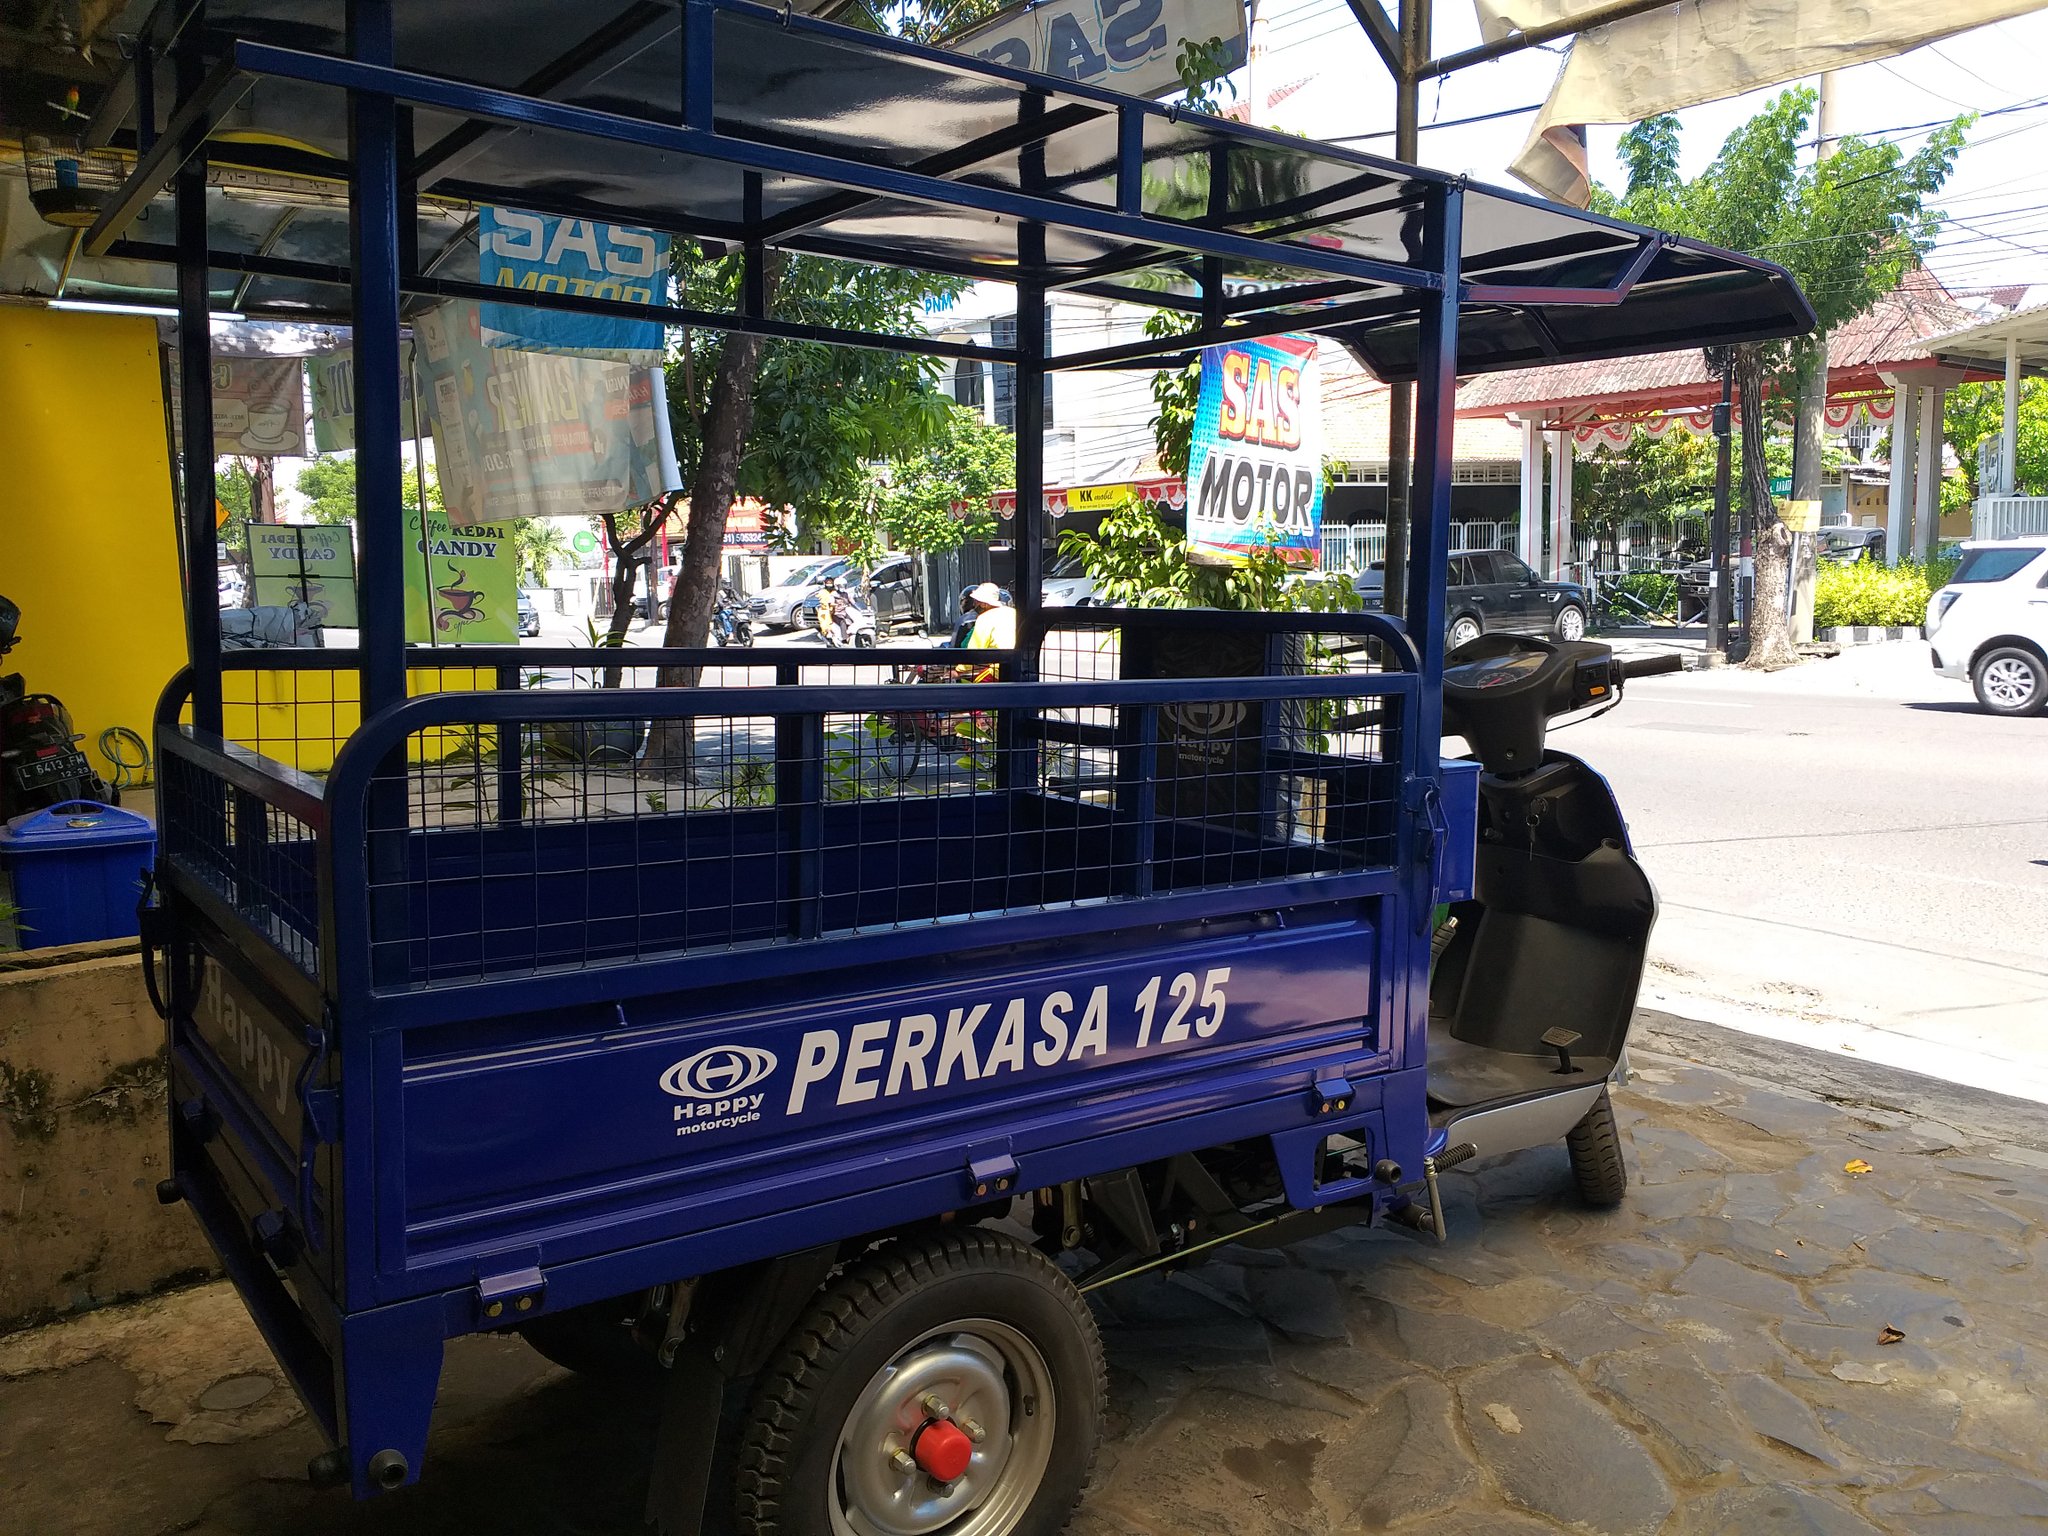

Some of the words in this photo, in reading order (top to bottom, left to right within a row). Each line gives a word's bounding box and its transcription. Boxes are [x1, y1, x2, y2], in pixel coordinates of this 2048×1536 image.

[492, 207, 656, 278] SAS
[925, 292, 953, 315] PNM
[1218, 350, 1300, 452] SAS
[1080, 490, 1093, 502] KK
[1196, 451, 1313, 531] MOTOR
[409, 515, 448, 539] Cffee
[417, 540, 497, 558] GANDY
[22, 768, 31, 778] L
[36, 760, 64, 775] 6413
[69, 753, 86, 766] FM
[1178, 752, 1225, 766] motorcycle
[204, 956, 291, 1116] Happy
[786, 985, 1109, 1116] PERKASA
[1134, 966, 1232, 1048] 125
[673, 1092, 765, 1121] Happy
[676, 1111, 761, 1137] motorcycle
